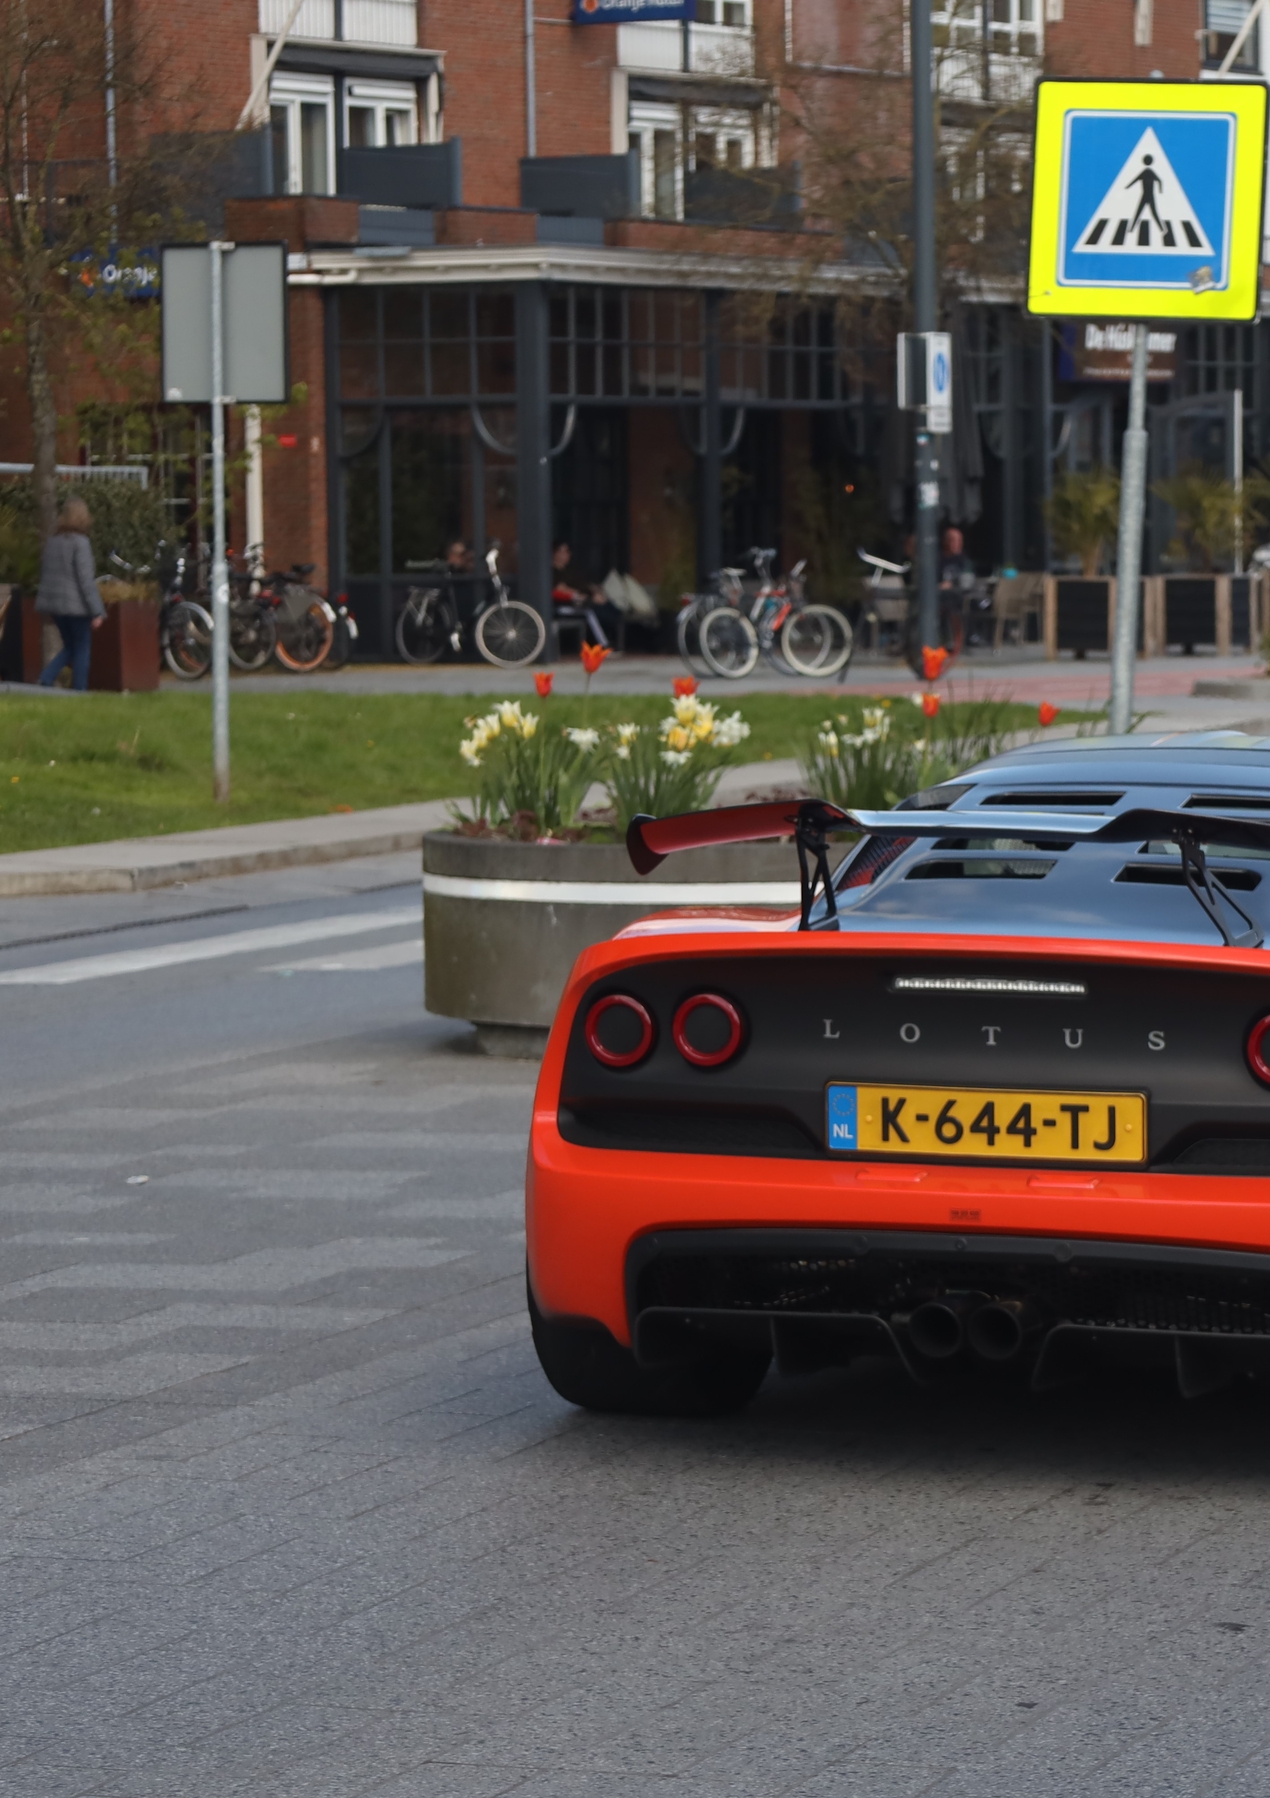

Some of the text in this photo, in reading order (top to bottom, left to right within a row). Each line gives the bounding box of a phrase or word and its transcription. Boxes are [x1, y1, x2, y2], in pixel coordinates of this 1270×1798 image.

[823, 1018, 1167, 1051] LOTUS
[832, 1123, 854, 1139] NL
[880, 1096, 1117, 1152] K-644-TJ
